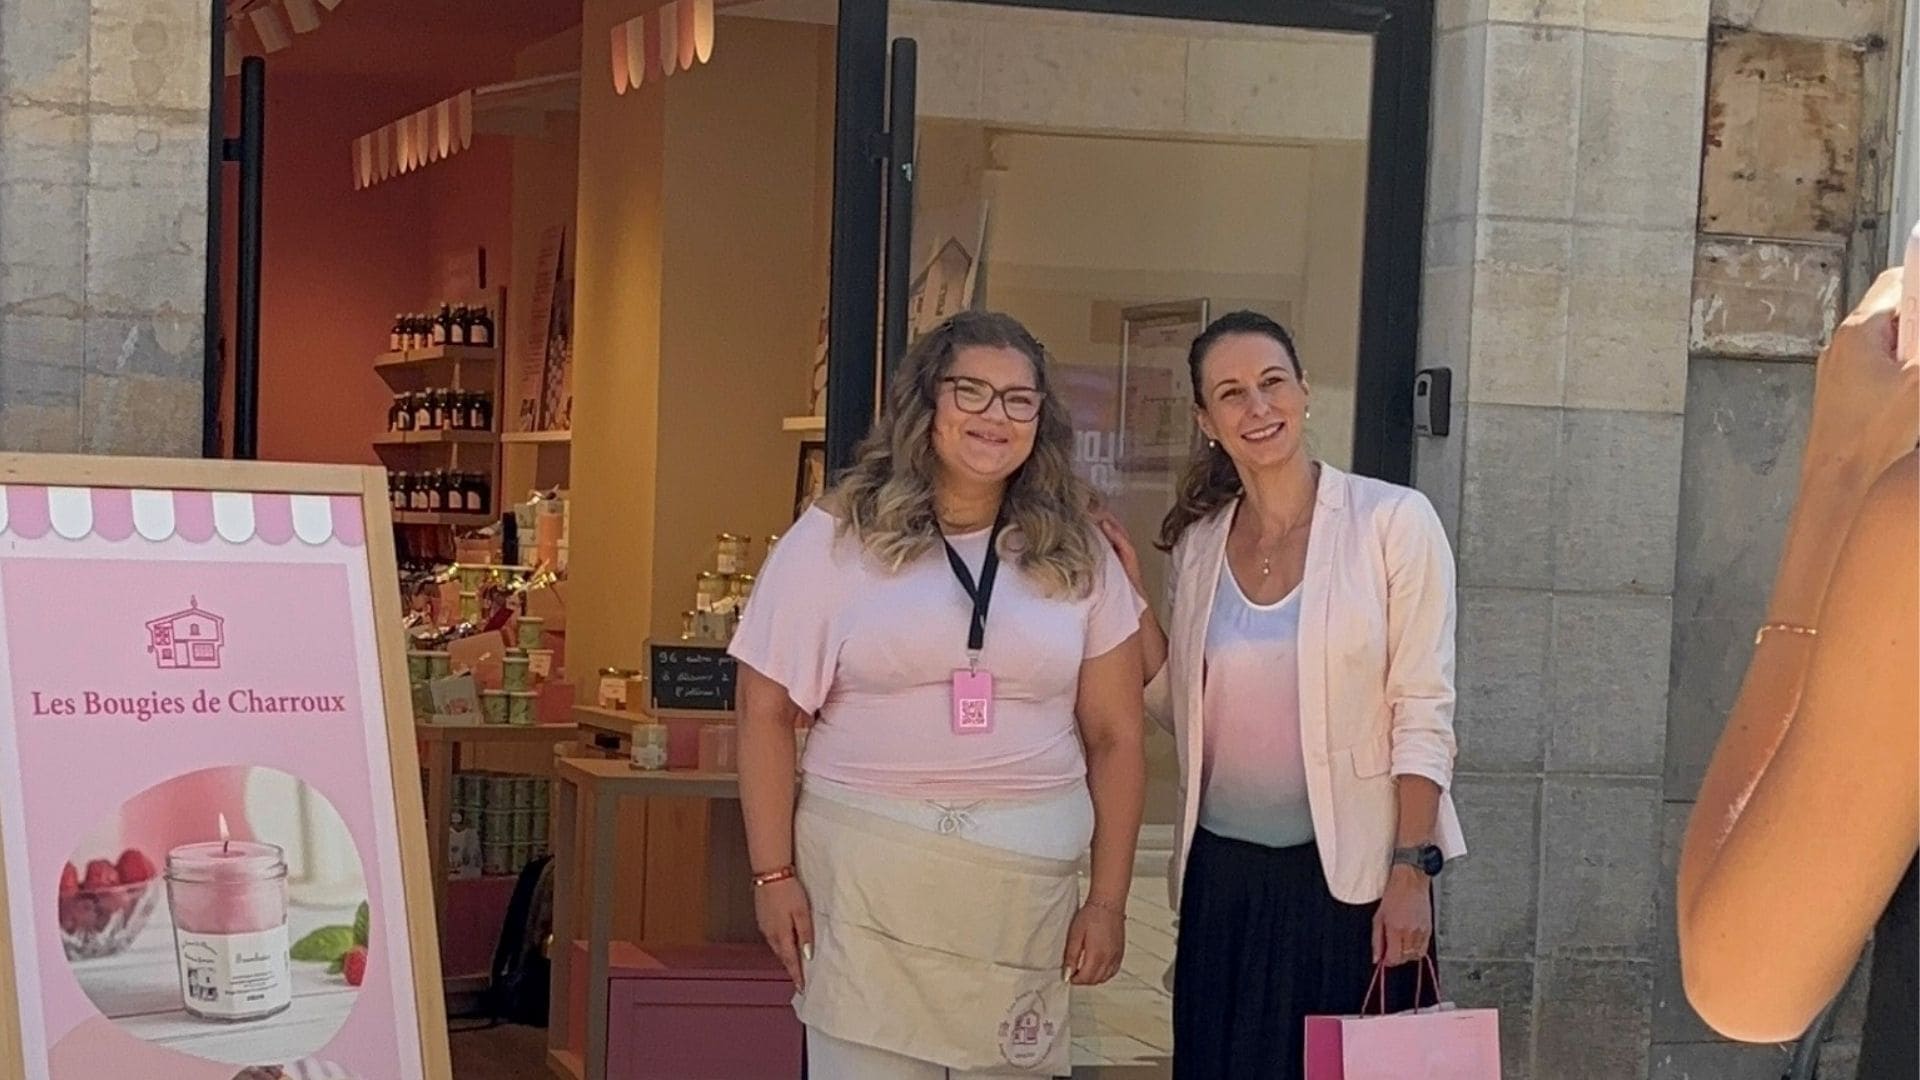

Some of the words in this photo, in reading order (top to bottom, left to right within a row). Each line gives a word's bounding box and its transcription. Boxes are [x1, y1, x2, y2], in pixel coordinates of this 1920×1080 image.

[659, 651, 678, 663] 96
[32, 691, 76, 716] Les
[83, 690, 185, 722] Bougies
[192, 689, 221, 714] de
[228, 689, 346, 714] Charroux
